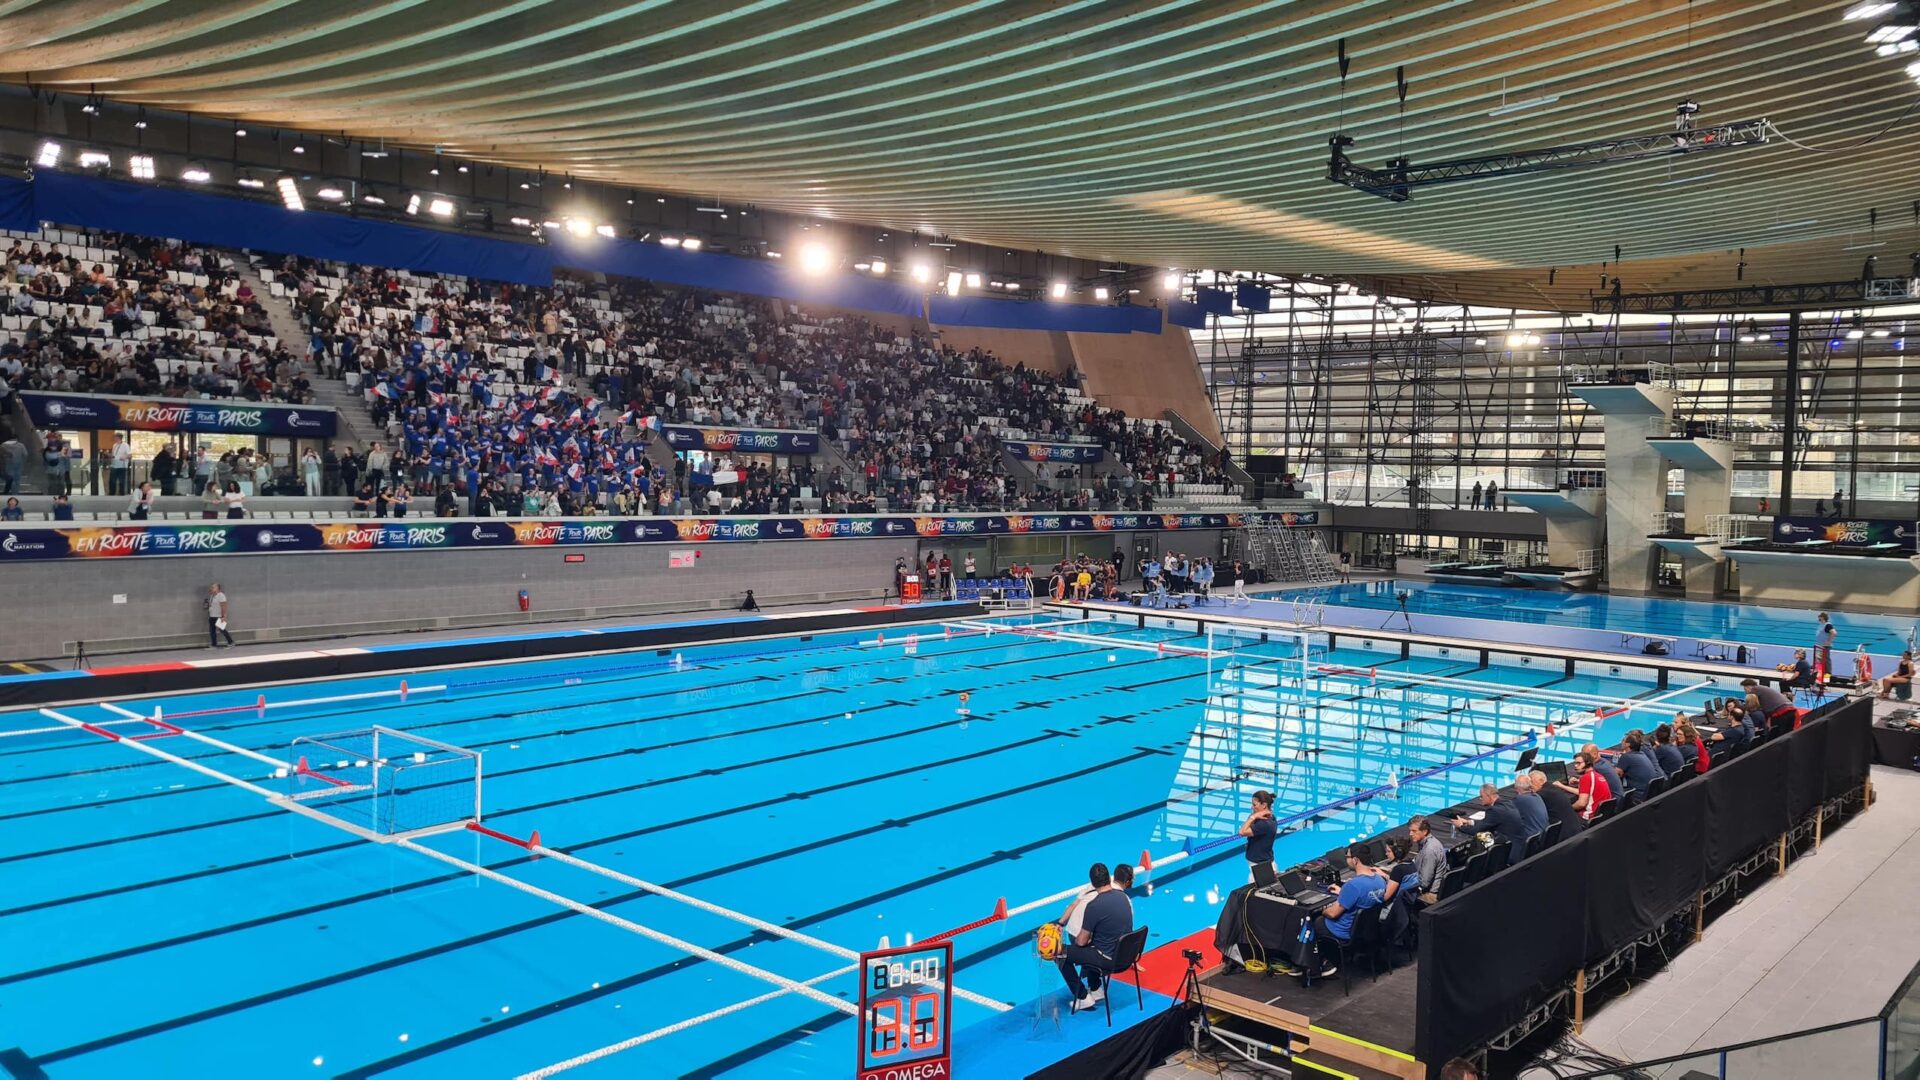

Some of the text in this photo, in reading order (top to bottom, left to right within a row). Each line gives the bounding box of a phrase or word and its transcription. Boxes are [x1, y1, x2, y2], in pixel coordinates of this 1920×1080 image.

[125, 407, 262, 427] EN ROUTE POUR PARIS
[707, 436, 716, 445] EN
[718, 434, 742, 446] ROUTE
[754, 434, 778, 447] PARIS
[519, 530, 532, 541] EN
[532, 525, 566, 540] ROUTE
[583, 524, 614, 540] PARIS
[680, 527, 691, 536] EN
[692, 523, 720, 536] ROUTE
[733, 523, 759, 537] PARIS
[807, 525, 815, 533] EN
[816, 522, 839, 533] ROUTE
[850, 521, 872, 534] PARIS
[926, 521, 946, 532] ROUTE
[956, 521, 975, 532] PARIS
[76, 530, 226, 552] EN ROUTE POUR PARIS
[328, 527, 446, 545] EN ROUTE POUR PARIS
[1836, 531, 1868, 543] PARIS
[886, 1062, 946, 1080] OMEGA
